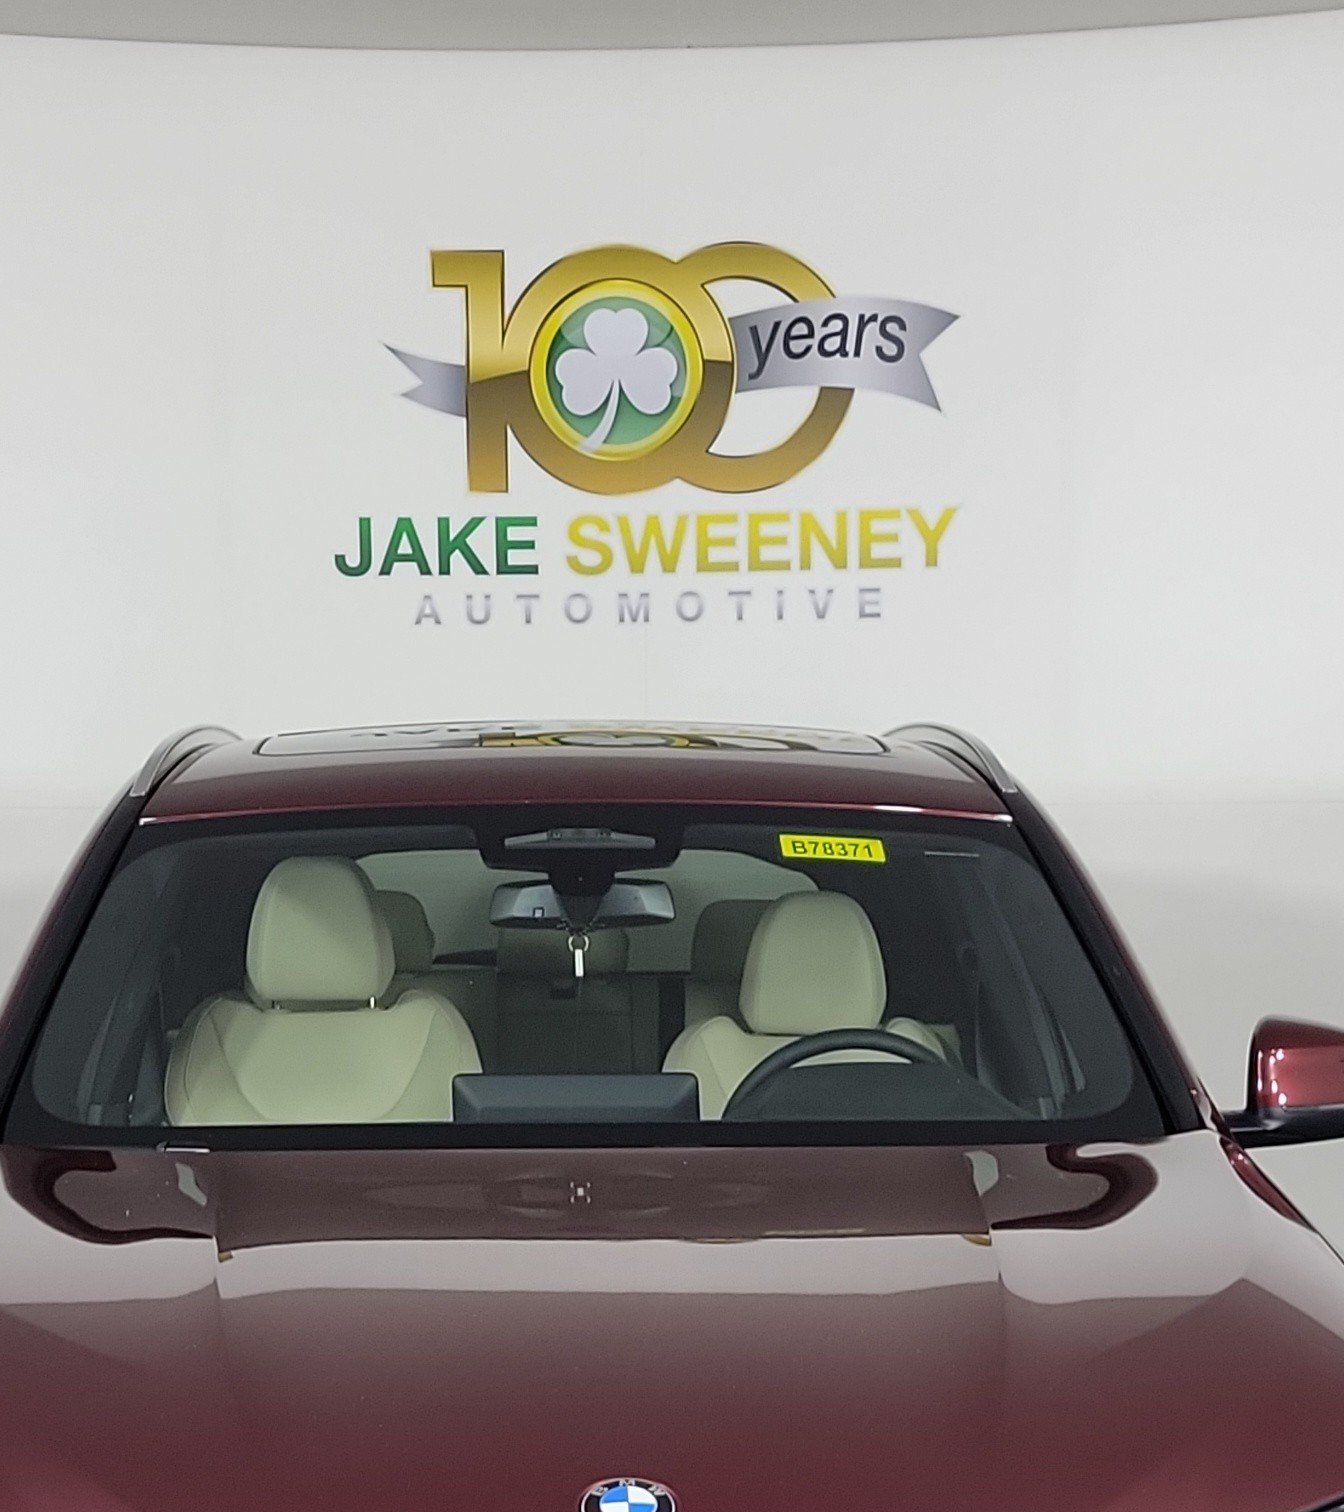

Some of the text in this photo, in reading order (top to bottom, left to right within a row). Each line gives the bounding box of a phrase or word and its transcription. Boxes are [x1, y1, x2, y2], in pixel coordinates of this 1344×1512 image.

[429, 241, 856, 495] 100
[747, 311, 908, 381] years
[333, 505, 960, 578] JAKE SWEENEY
[414, 586, 884, 626] AUTOMOTIVE
[791, 840, 873, 858] B78371
